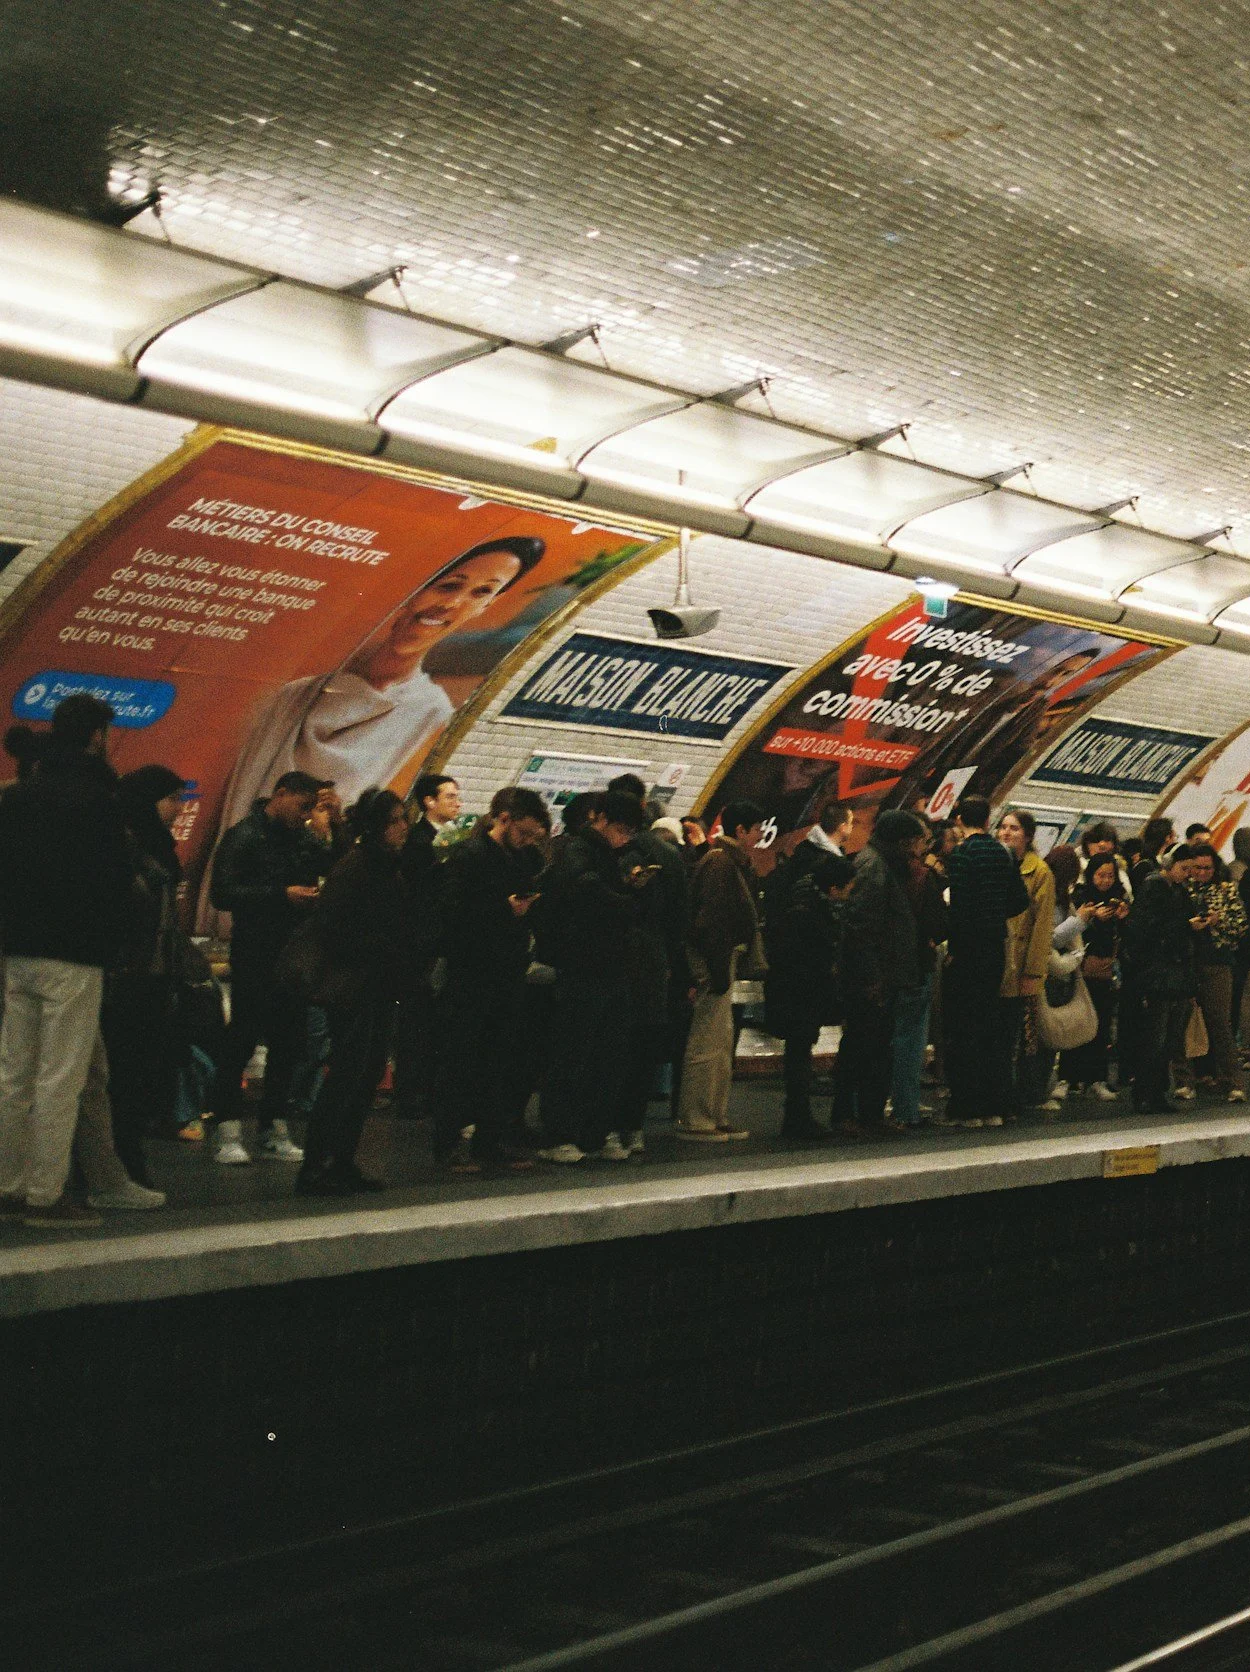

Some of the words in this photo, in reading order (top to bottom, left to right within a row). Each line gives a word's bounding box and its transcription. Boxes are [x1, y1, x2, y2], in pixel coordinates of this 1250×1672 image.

[166, 514, 272, 544] BANCAIRE
[274, 534, 310, 550] ON
[304, 539, 390, 566] RECRUTE
[187, 498, 277, 524] MÉTIERS
[270, 512, 308, 529] DU
[302, 519, 379, 545] CONSEIL
[111, 566, 139, 582] de
[136, 571, 218, 595] rejoindre
[218, 585, 253, 600] une
[252, 589, 316, 611] banque
[131, 547, 177, 567] Vous
[175, 556, 220, 575] allez
[218, 565, 262, 582] vous
[259, 568, 327, 592] étonner
[74, 604, 139, 626] autant
[137, 614, 164, 629] en
[162, 617, 194, 633] ses
[192, 619, 249, 641] clients
[92, 584, 120, 601] de
[117, 588, 206, 615] proximité
[203, 600, 239, 618] qui
[234, 607, 276, 624] croit
[886, 616, 1031, 664] Investissez
[523, 650, 658, 711] MAISON
[631, 666, 769, 725] BLANCHE
[842, 653, 916, 683] avec
[907, 660, 942, 686] 0
[930, 664, 963, 691] %
[951, 668, 993, 697] de
[769, 735, 793, 748] sur
[812, 739, 840, 755] 000
[834, 742, 878, 760] actions
[874, 750, 891, 762] et
[886, 750, 914, 764] ETF
[1045, 730, 1133, 775] MAISON
[1107, 739, 1198, 784] BLANCHE
